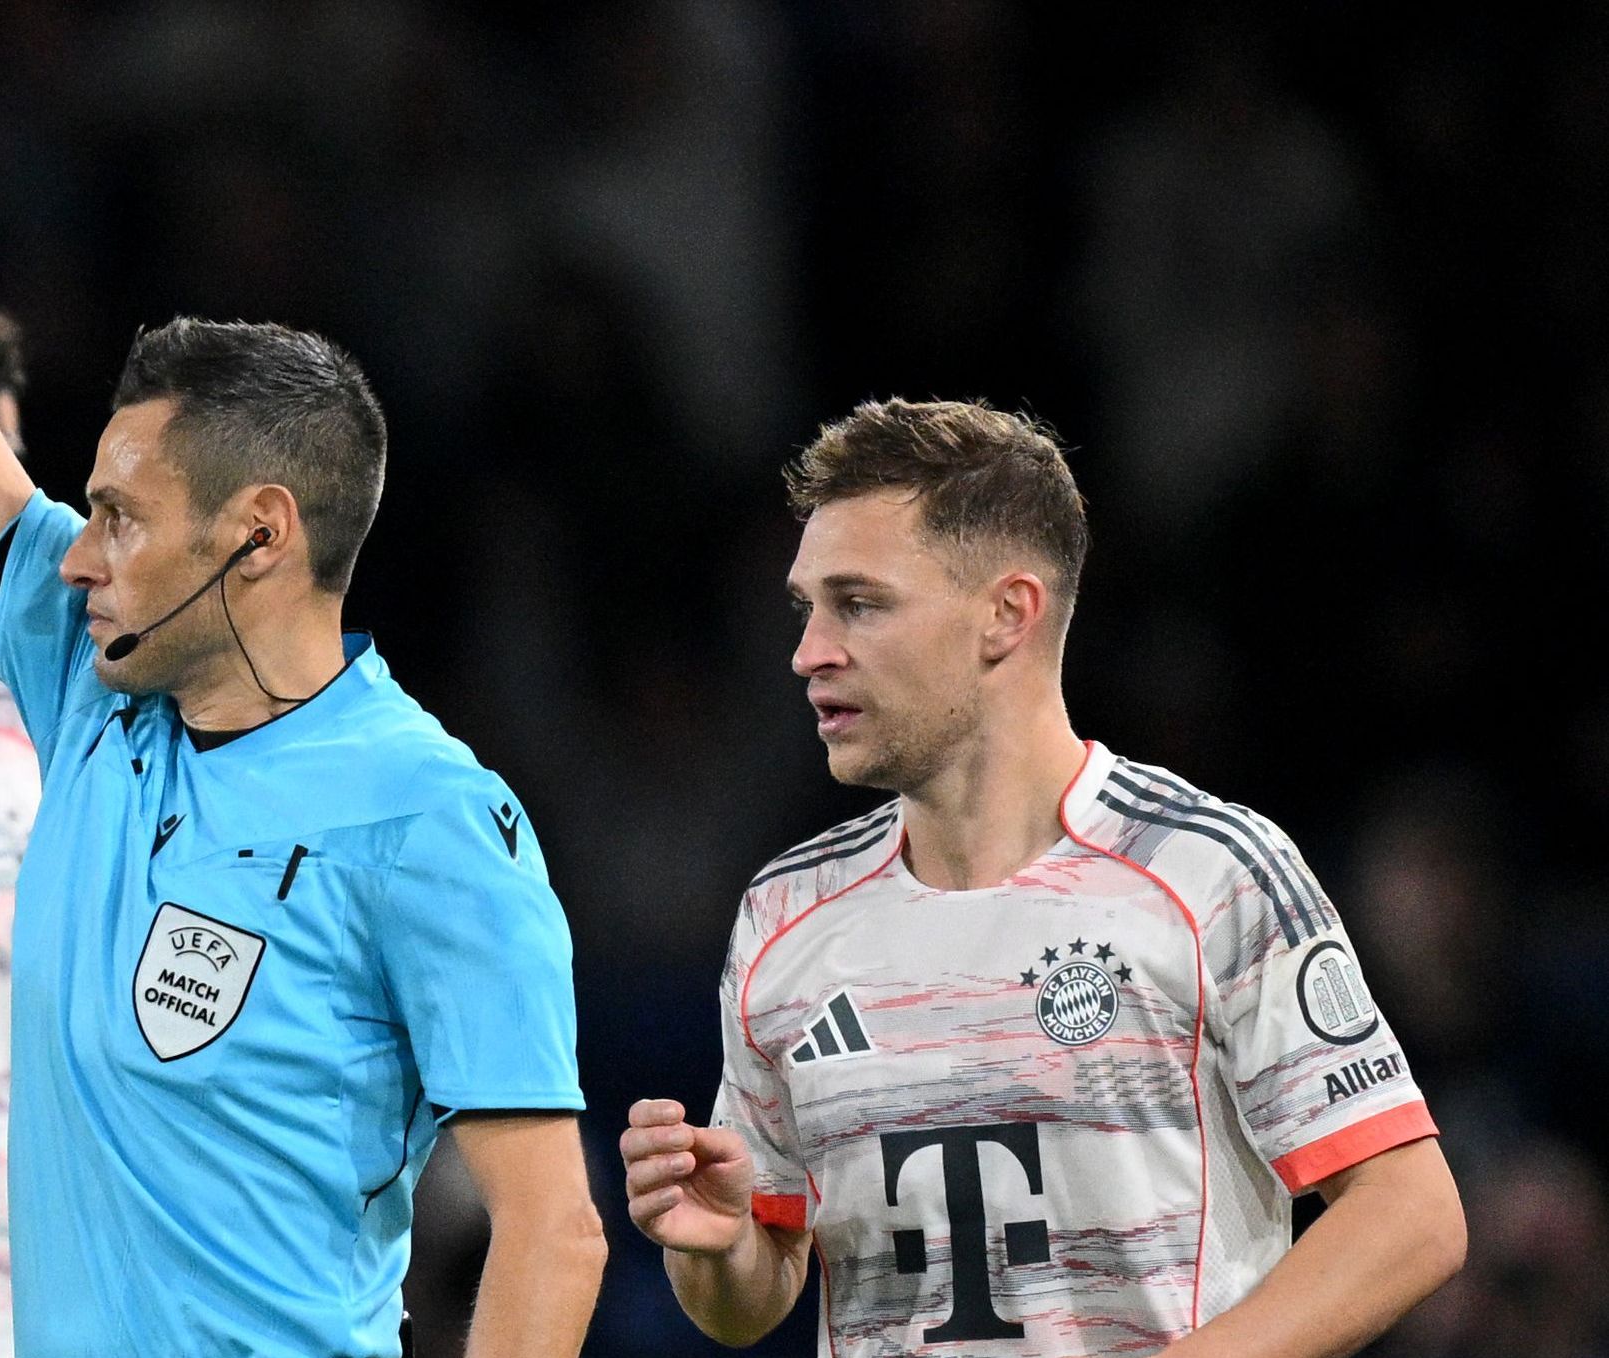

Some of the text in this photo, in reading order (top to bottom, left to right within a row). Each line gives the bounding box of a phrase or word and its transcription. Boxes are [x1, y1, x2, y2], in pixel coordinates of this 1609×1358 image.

[171, 932, 232, 969] UEFA
[157, 968, 221, 1003] MATCH
[1043, 967, 1112, 1000] FC BAYERN
[144, 987, 217, 1027] OFFICIAL
